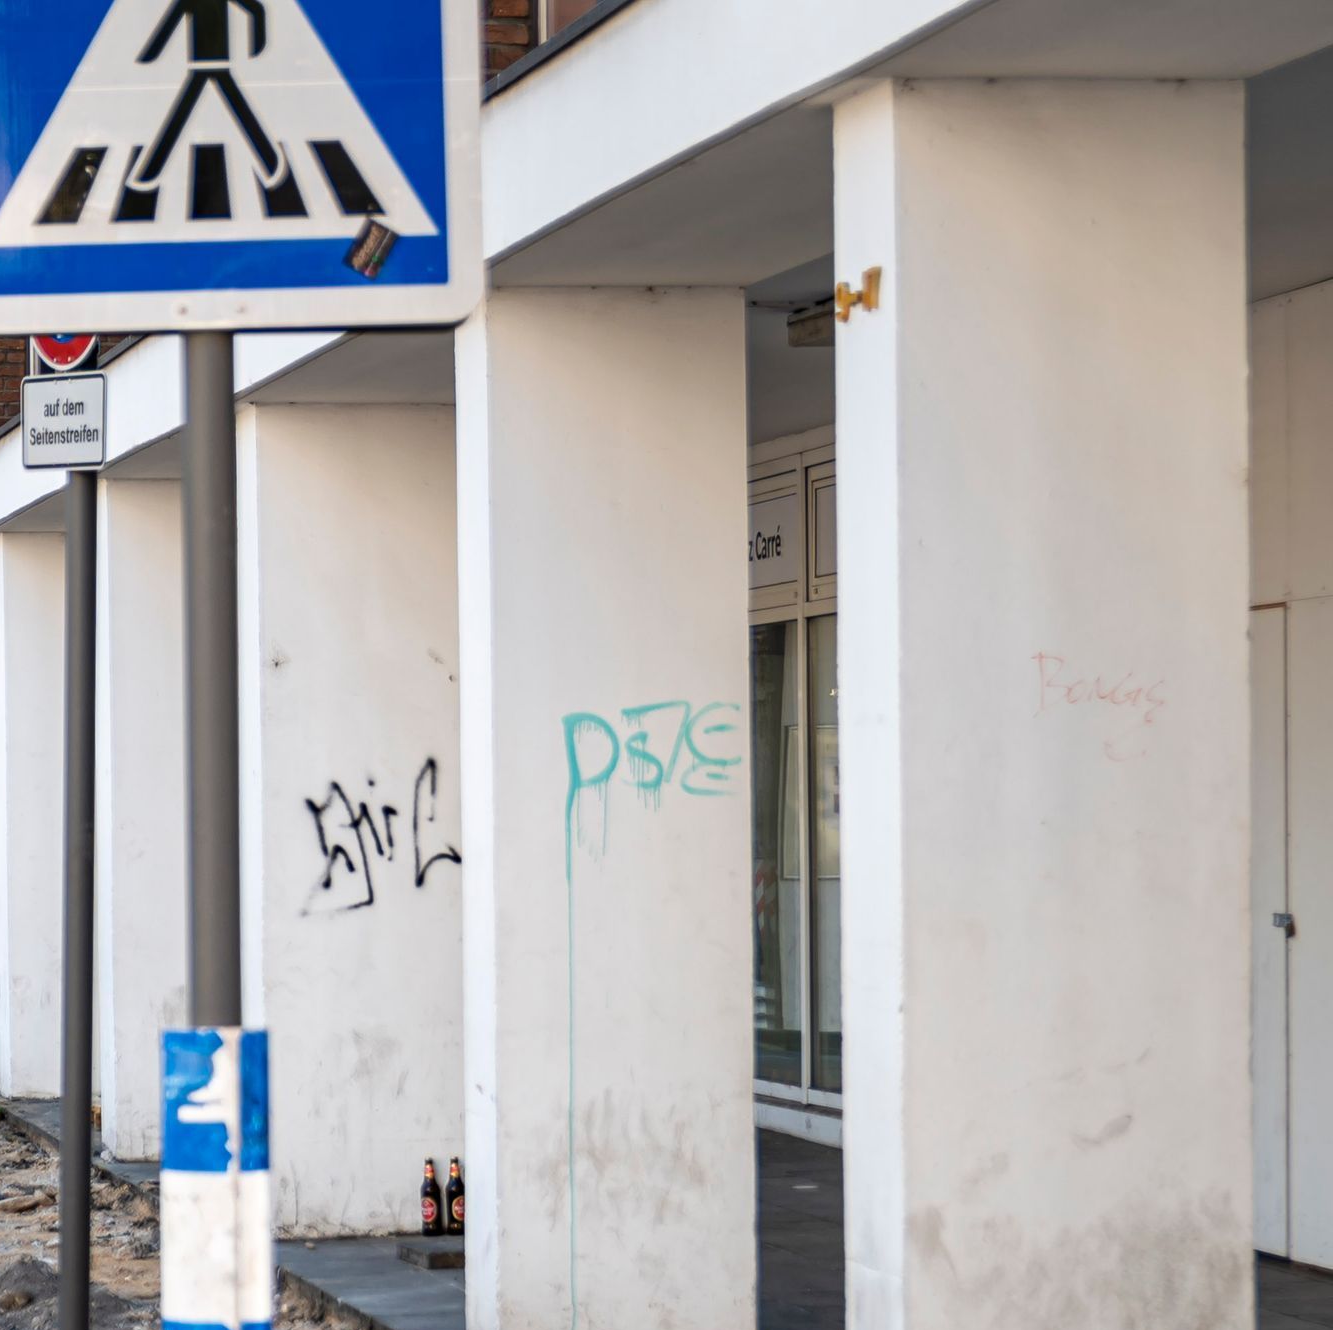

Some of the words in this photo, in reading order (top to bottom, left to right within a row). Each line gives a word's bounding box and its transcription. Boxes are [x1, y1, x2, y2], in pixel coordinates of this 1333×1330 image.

[44, 398, 60, 417] auf
[62, 398, 84, 416] dem
[29, 424, 99, 446] Seitenstreifen
[755, 524, 782, 560] Carré
